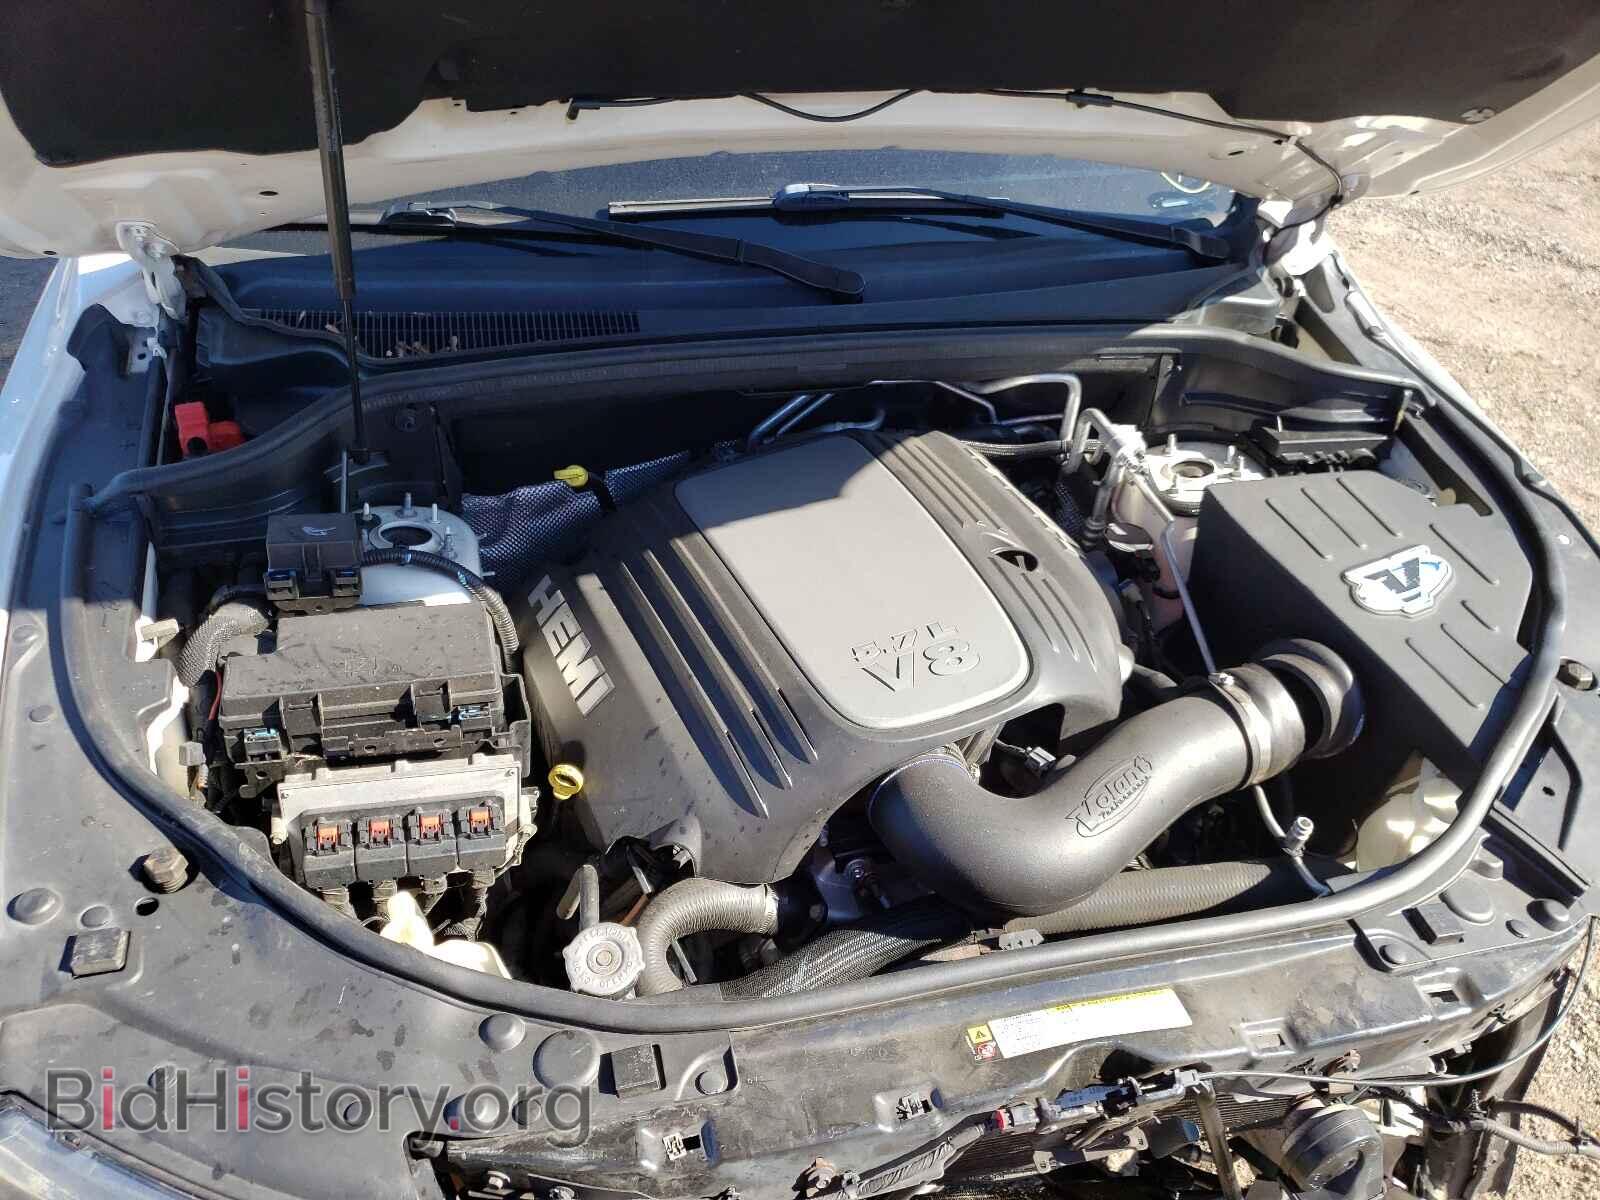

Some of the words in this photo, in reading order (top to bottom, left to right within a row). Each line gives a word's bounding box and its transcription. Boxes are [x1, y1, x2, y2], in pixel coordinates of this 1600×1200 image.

[528, 574, 616, 716] HEMI
[851, 621, 960, 662] 5.7L
[860, 639, 981, 692] V8
[1065, 754, 1153, 832] Volant
